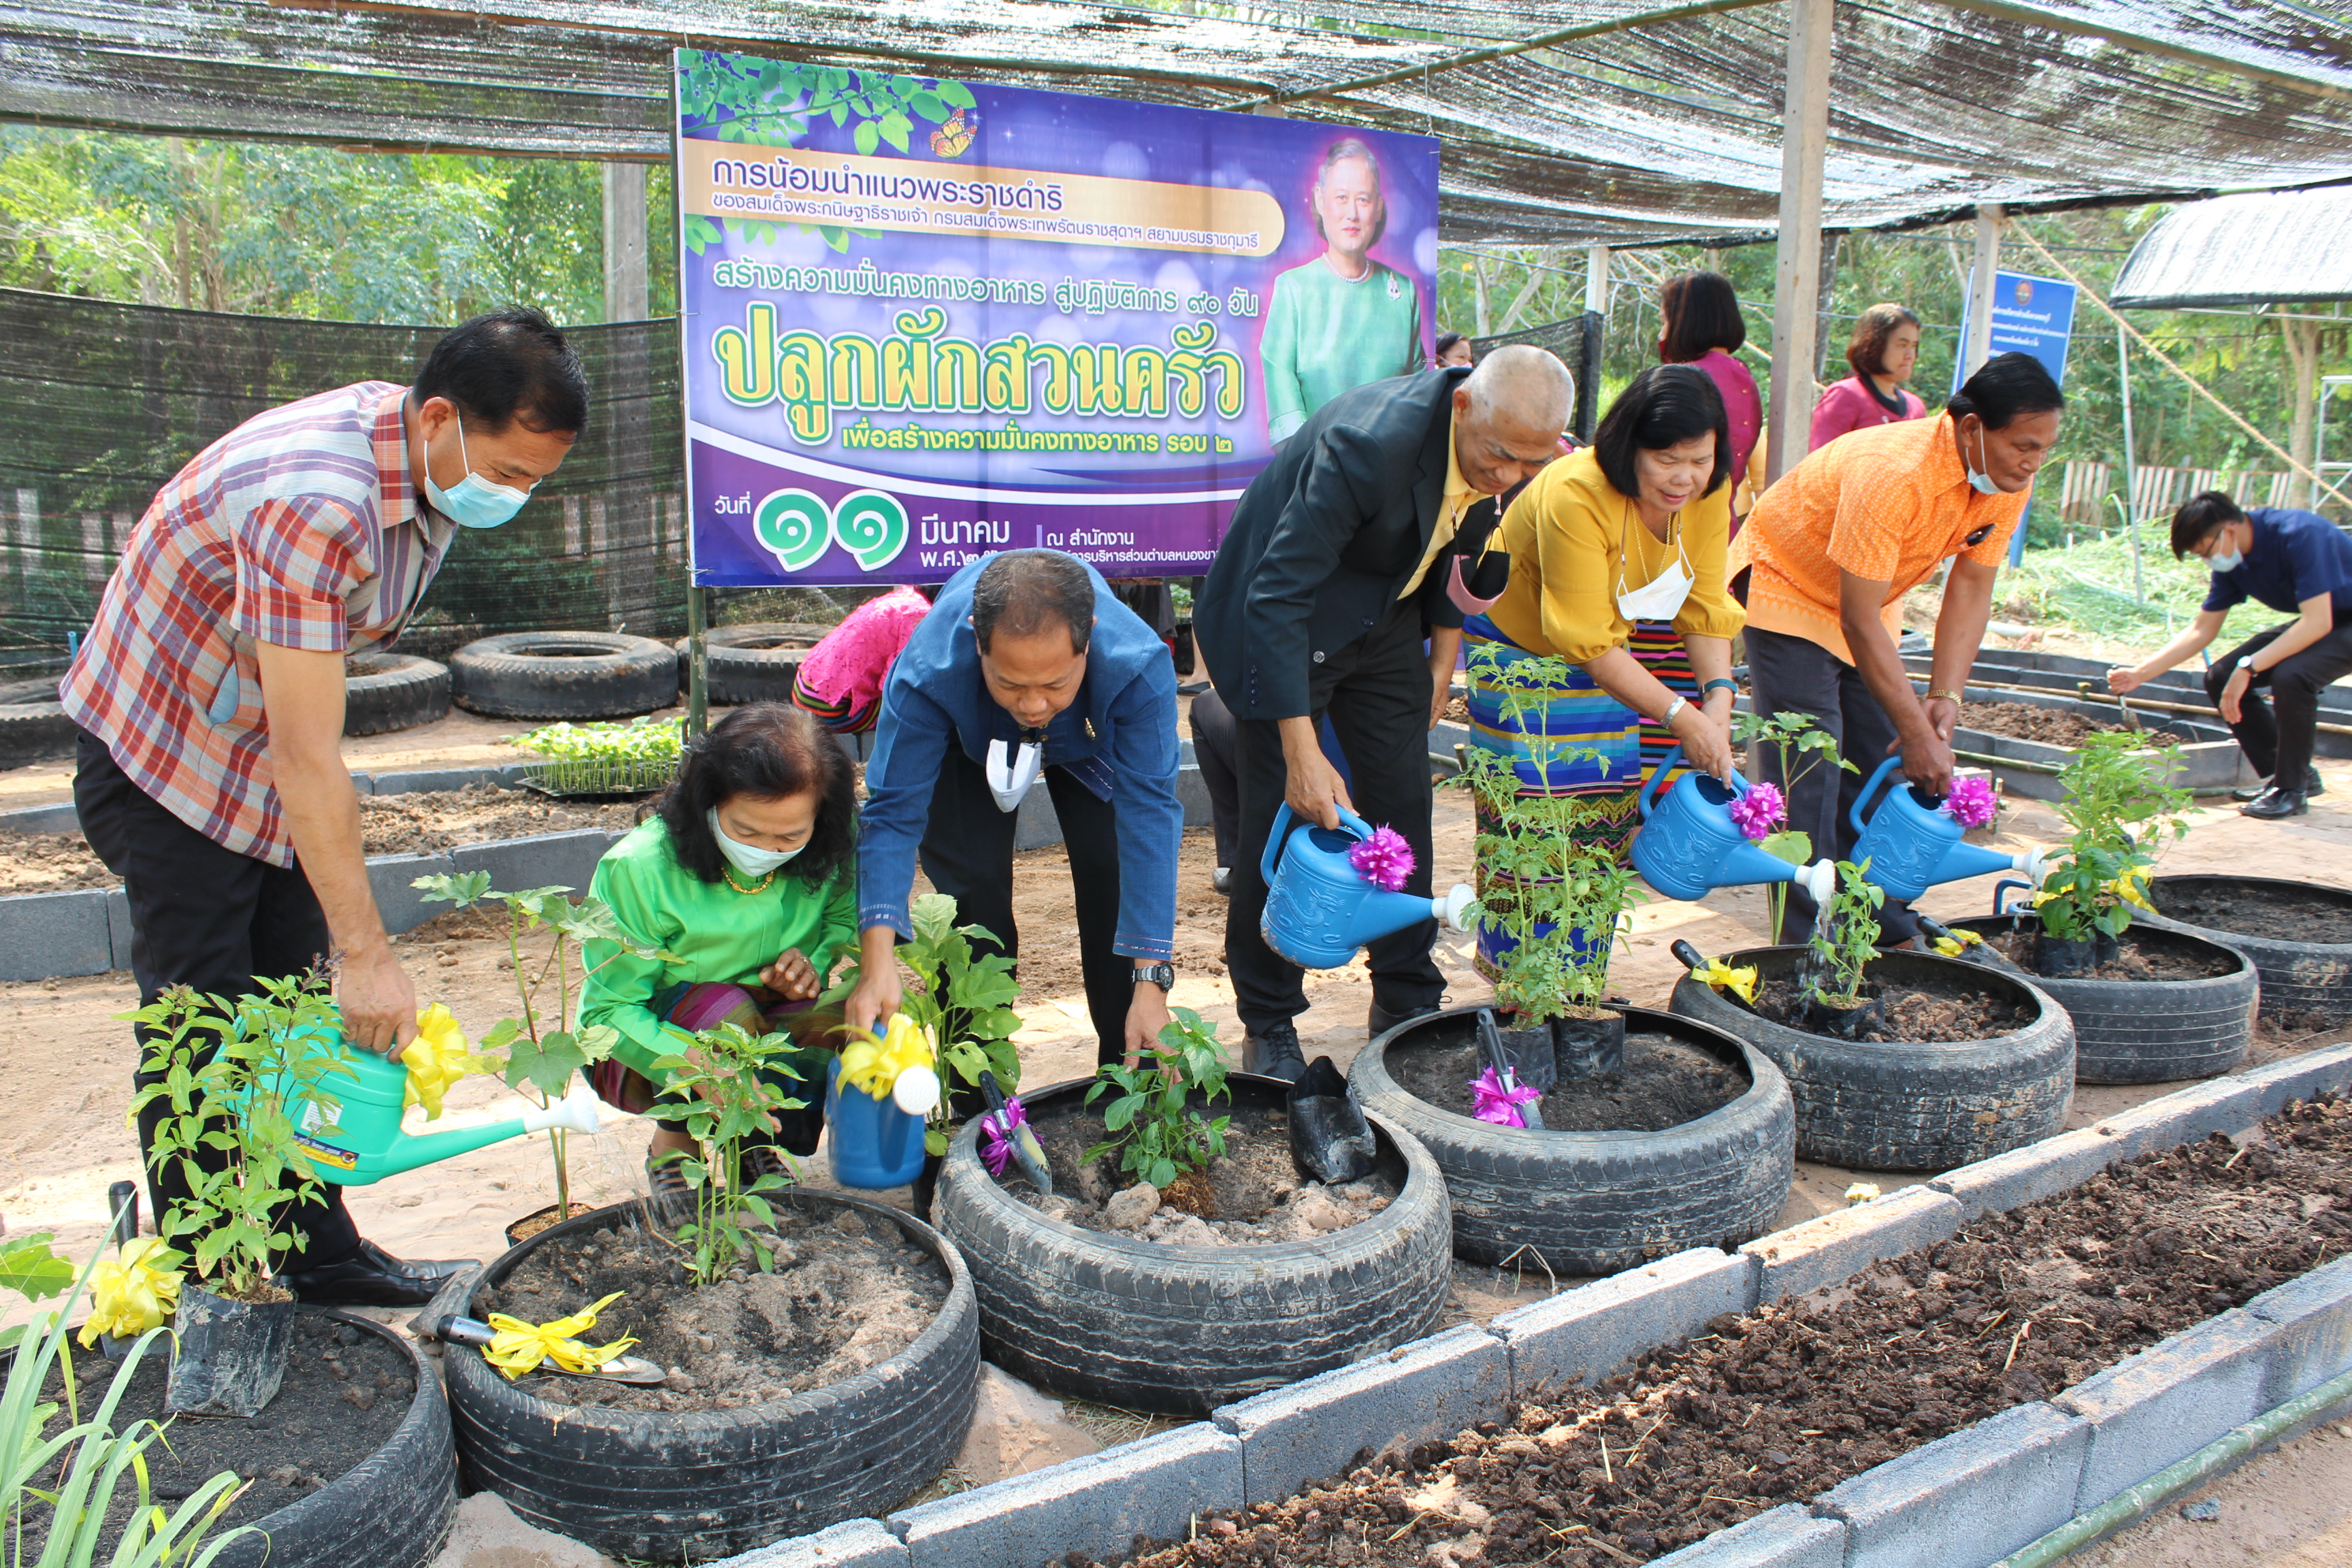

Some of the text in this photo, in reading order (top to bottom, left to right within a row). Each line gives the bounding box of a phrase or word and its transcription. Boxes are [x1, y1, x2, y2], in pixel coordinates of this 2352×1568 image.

[713, 157, 1063, 212] การน้อมนำแนวพระราชดำริ
[714, 193, 1259, 250] ของสมเด็จพระกนิษฐาธิราชเจ้า กรมสมเด็จพระเทพรัตนราชสุดาฯ สยามบรมราชกุมารี
[715, 256, 1258, 316] สร้างความมั่นคงทางอาหาร สู่ปฏิบัติการ ๙๐ วัน
[715, 302, 1243, 444] ปลูกผักสวนครัว
[843, 416, 1233, 453] เพื่อสร้างความมั่นคงทางอาหาร รอบ ๒
[715, 488, 1010, 572] วันที่ ๑๑ มีนาคม
[1046, 527, 1134, 546] ณ สำนักงาน
